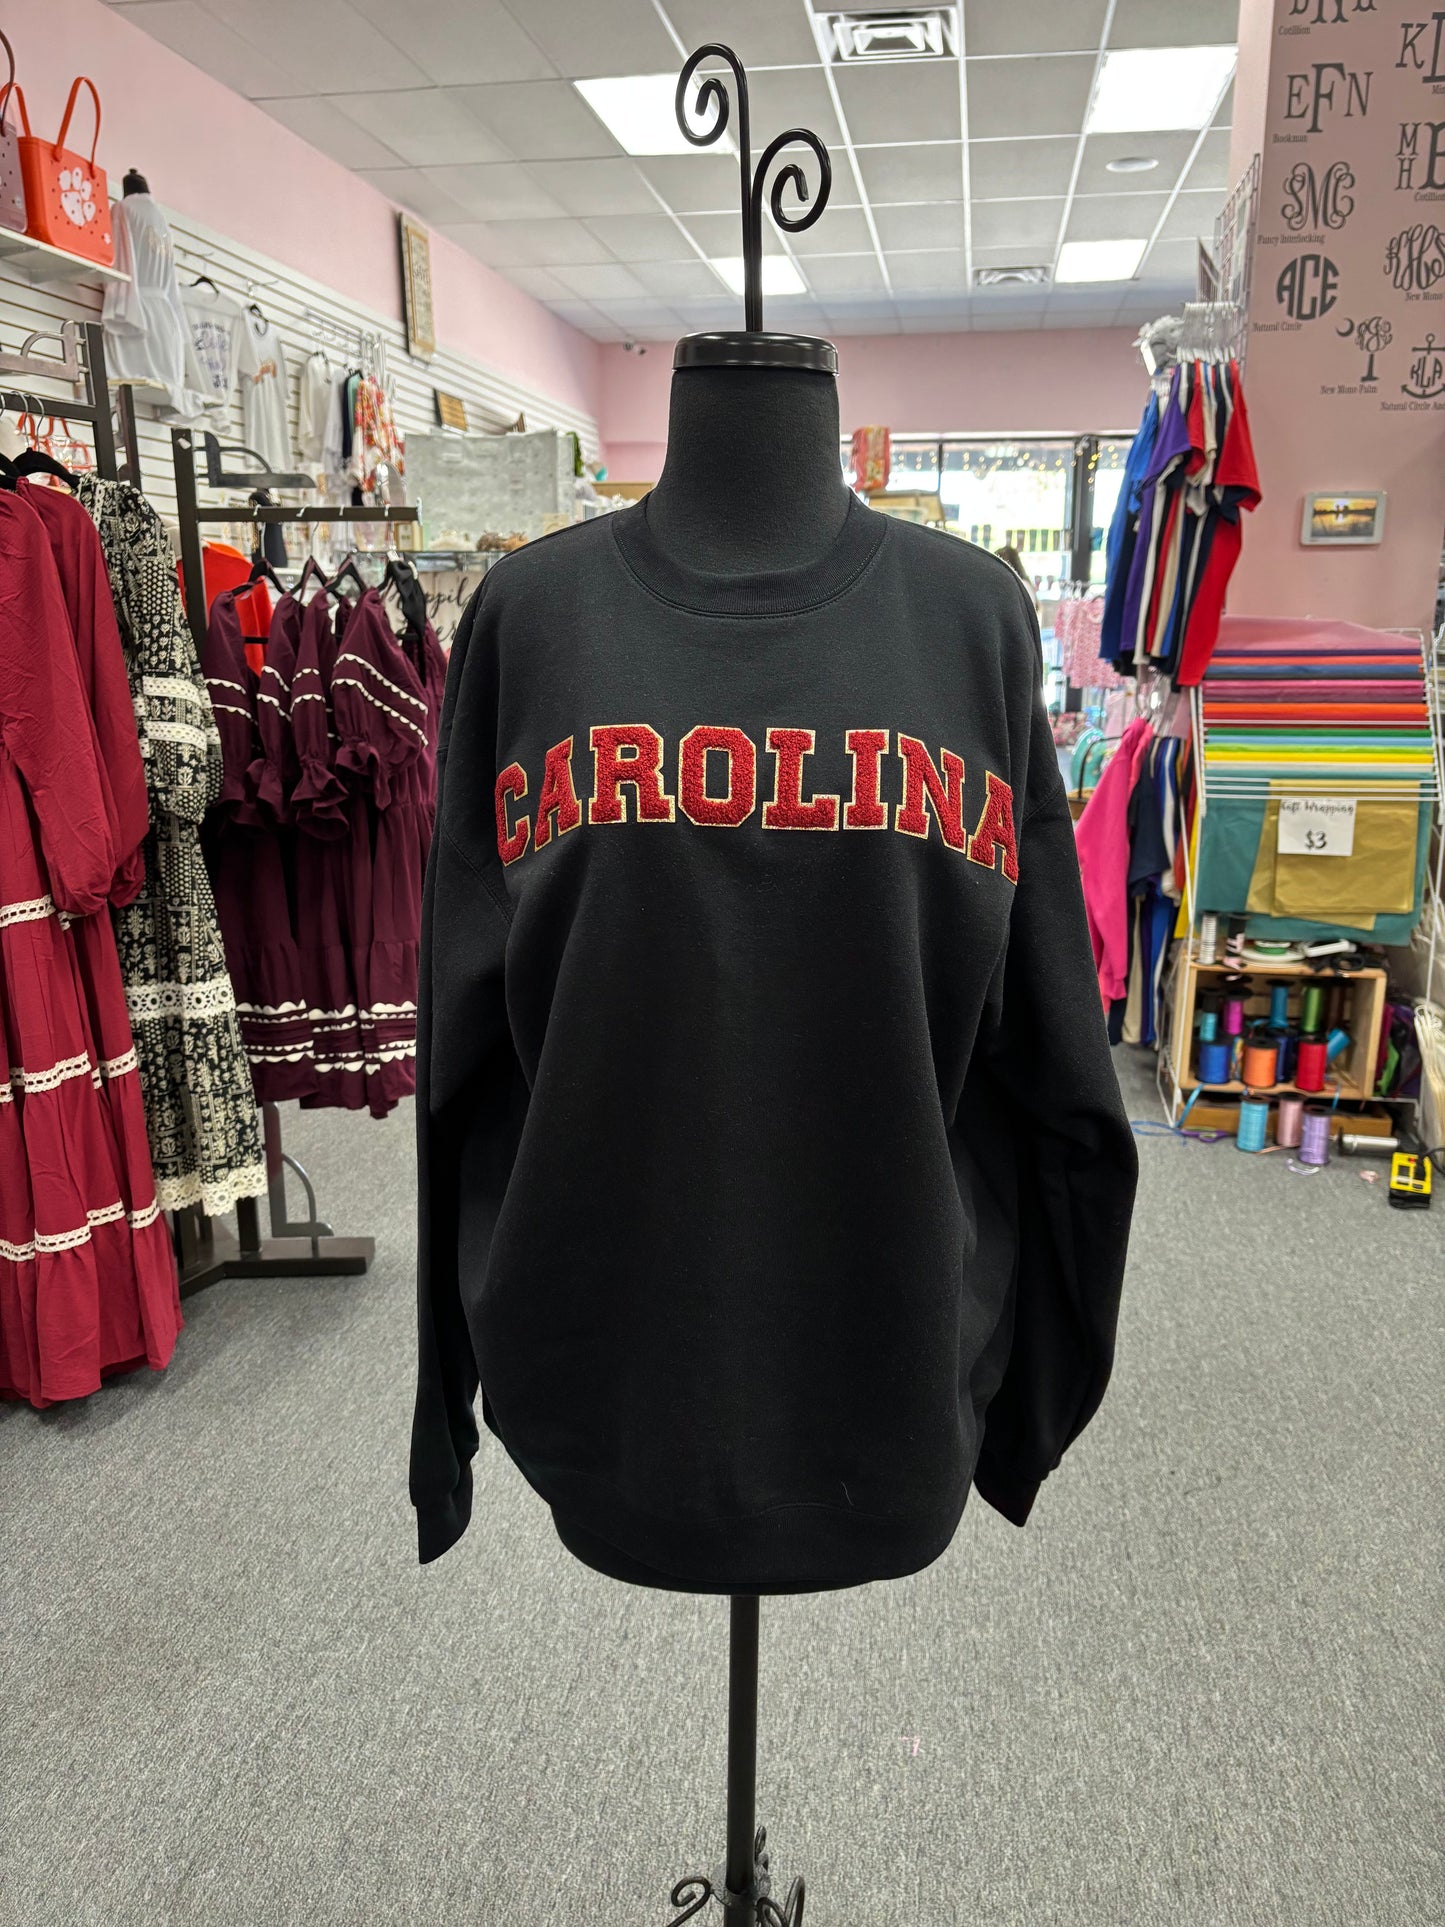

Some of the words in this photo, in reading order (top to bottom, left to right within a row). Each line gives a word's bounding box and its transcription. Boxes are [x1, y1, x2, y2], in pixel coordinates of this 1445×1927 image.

[1284, 63, 1374, 133] EFN
[1277, 253, 1340, 320] ACE
[494, 723, 1019, 886] CAROLINA
[1304, 829, 1327, 850] $3
